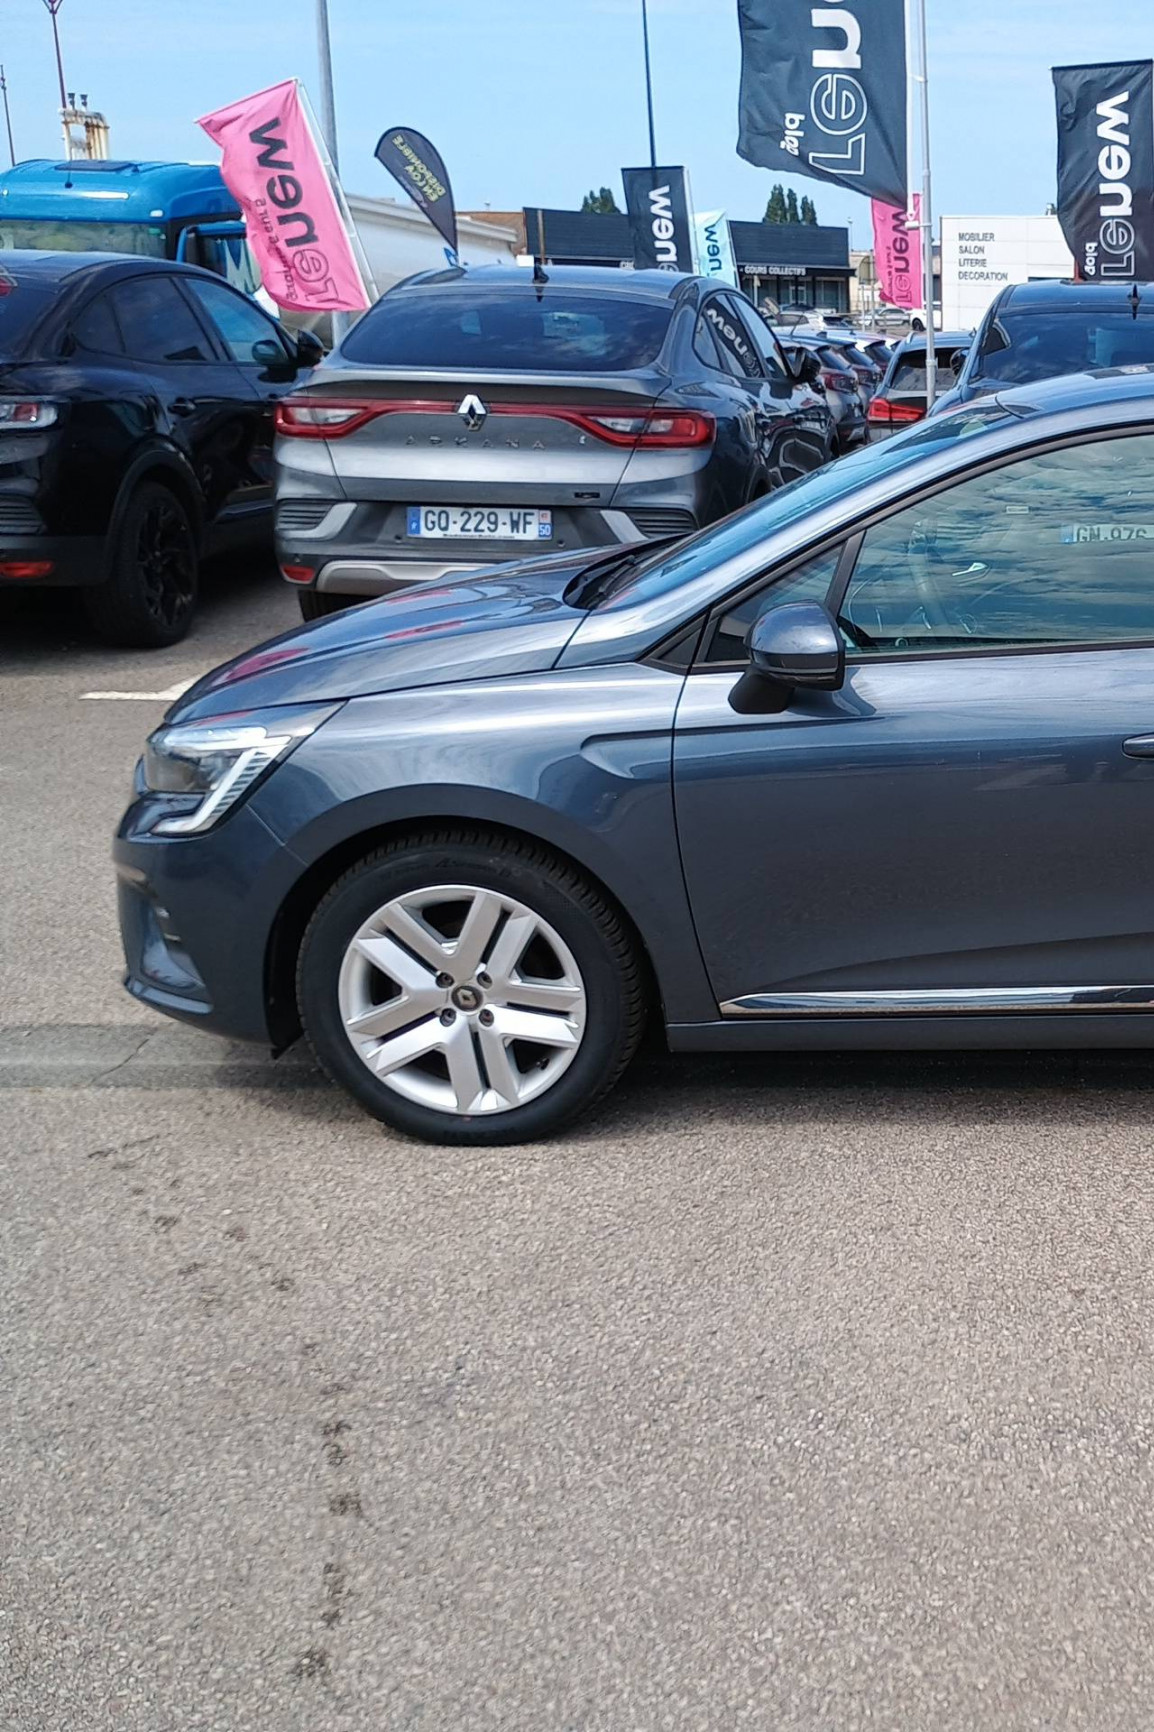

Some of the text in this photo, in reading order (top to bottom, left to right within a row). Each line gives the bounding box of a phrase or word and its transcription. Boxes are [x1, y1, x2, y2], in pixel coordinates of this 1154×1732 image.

[958, 232, 995, 242] MOBILIER
[958, 245, 985, 255] SALON
[958, 258, 987, 268] LITERIE
[744, 265, 806, 276] COURS COLLECTIFS
[958, 271, 1008, 281] DECORATION
[539, 525, 551, 536] 50
